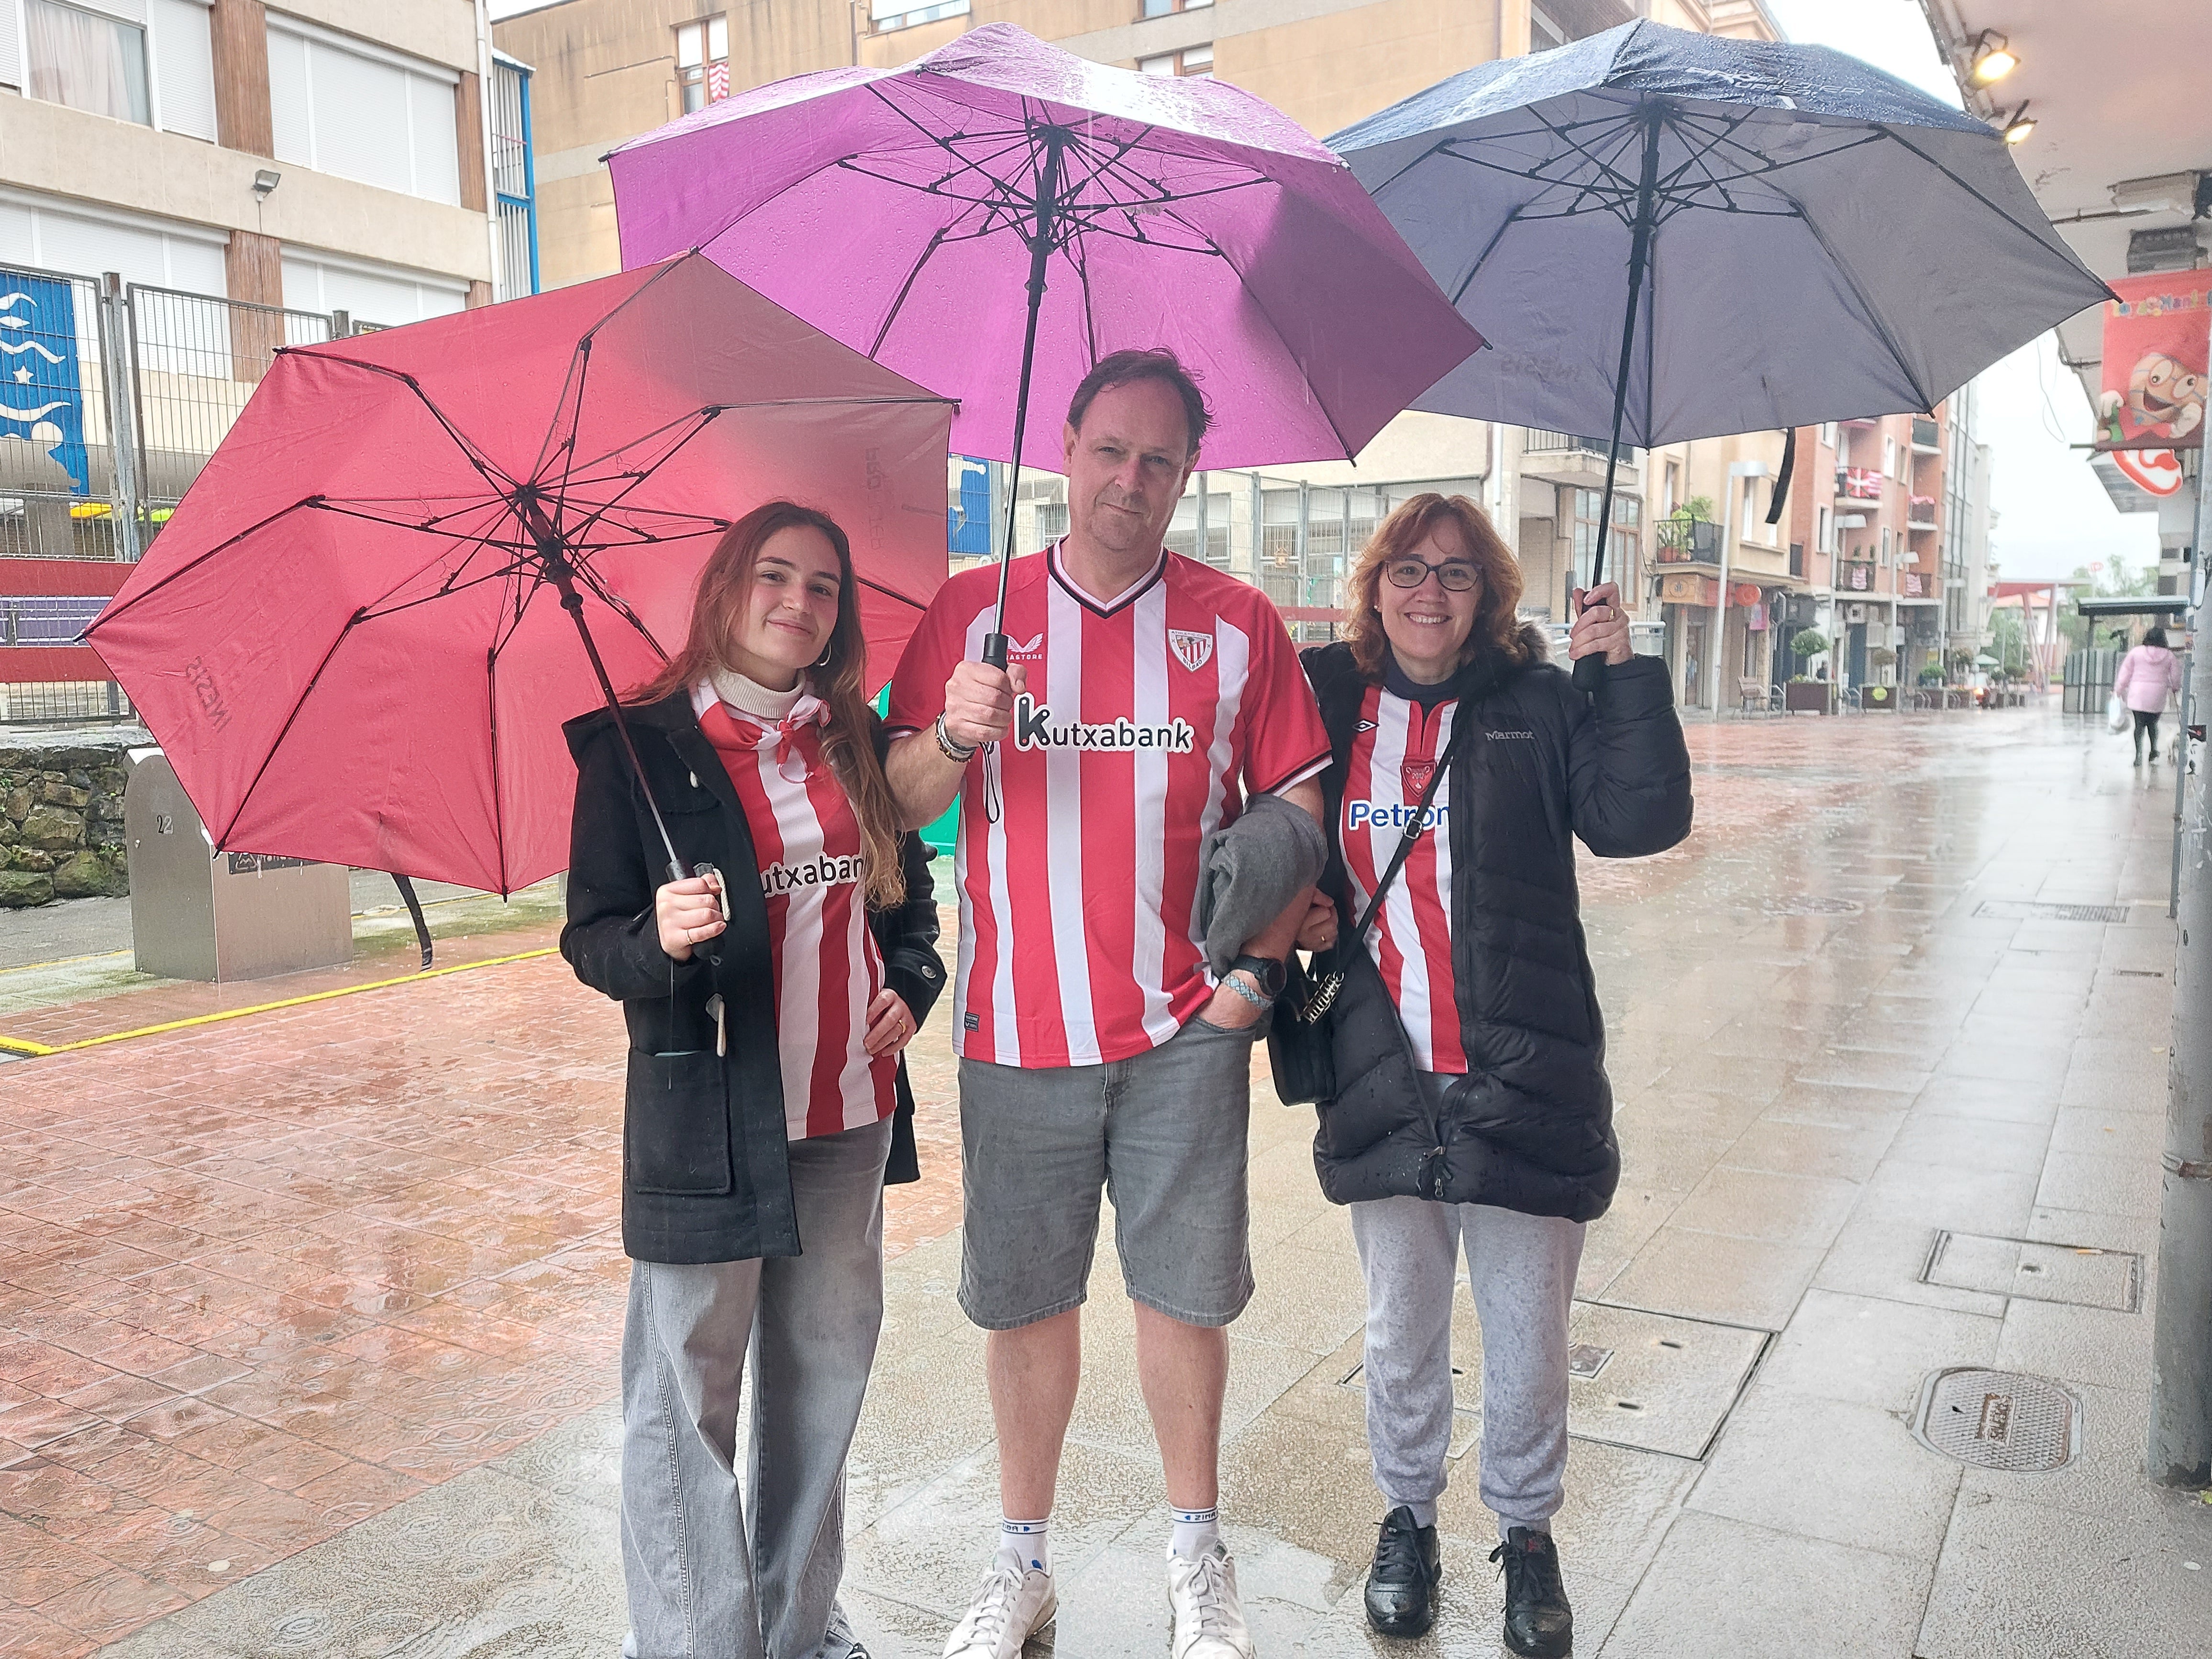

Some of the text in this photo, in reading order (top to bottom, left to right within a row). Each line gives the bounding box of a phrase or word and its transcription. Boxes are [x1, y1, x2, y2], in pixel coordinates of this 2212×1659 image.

[1183, 657, 1203, 670] BILBAO
[1485, 730, 1535, 741] Marmot
[156, 815, 174, 835] 22
[1351, 803, 1449, 827] Petron
[763, 855, 863, 893] utxaban
